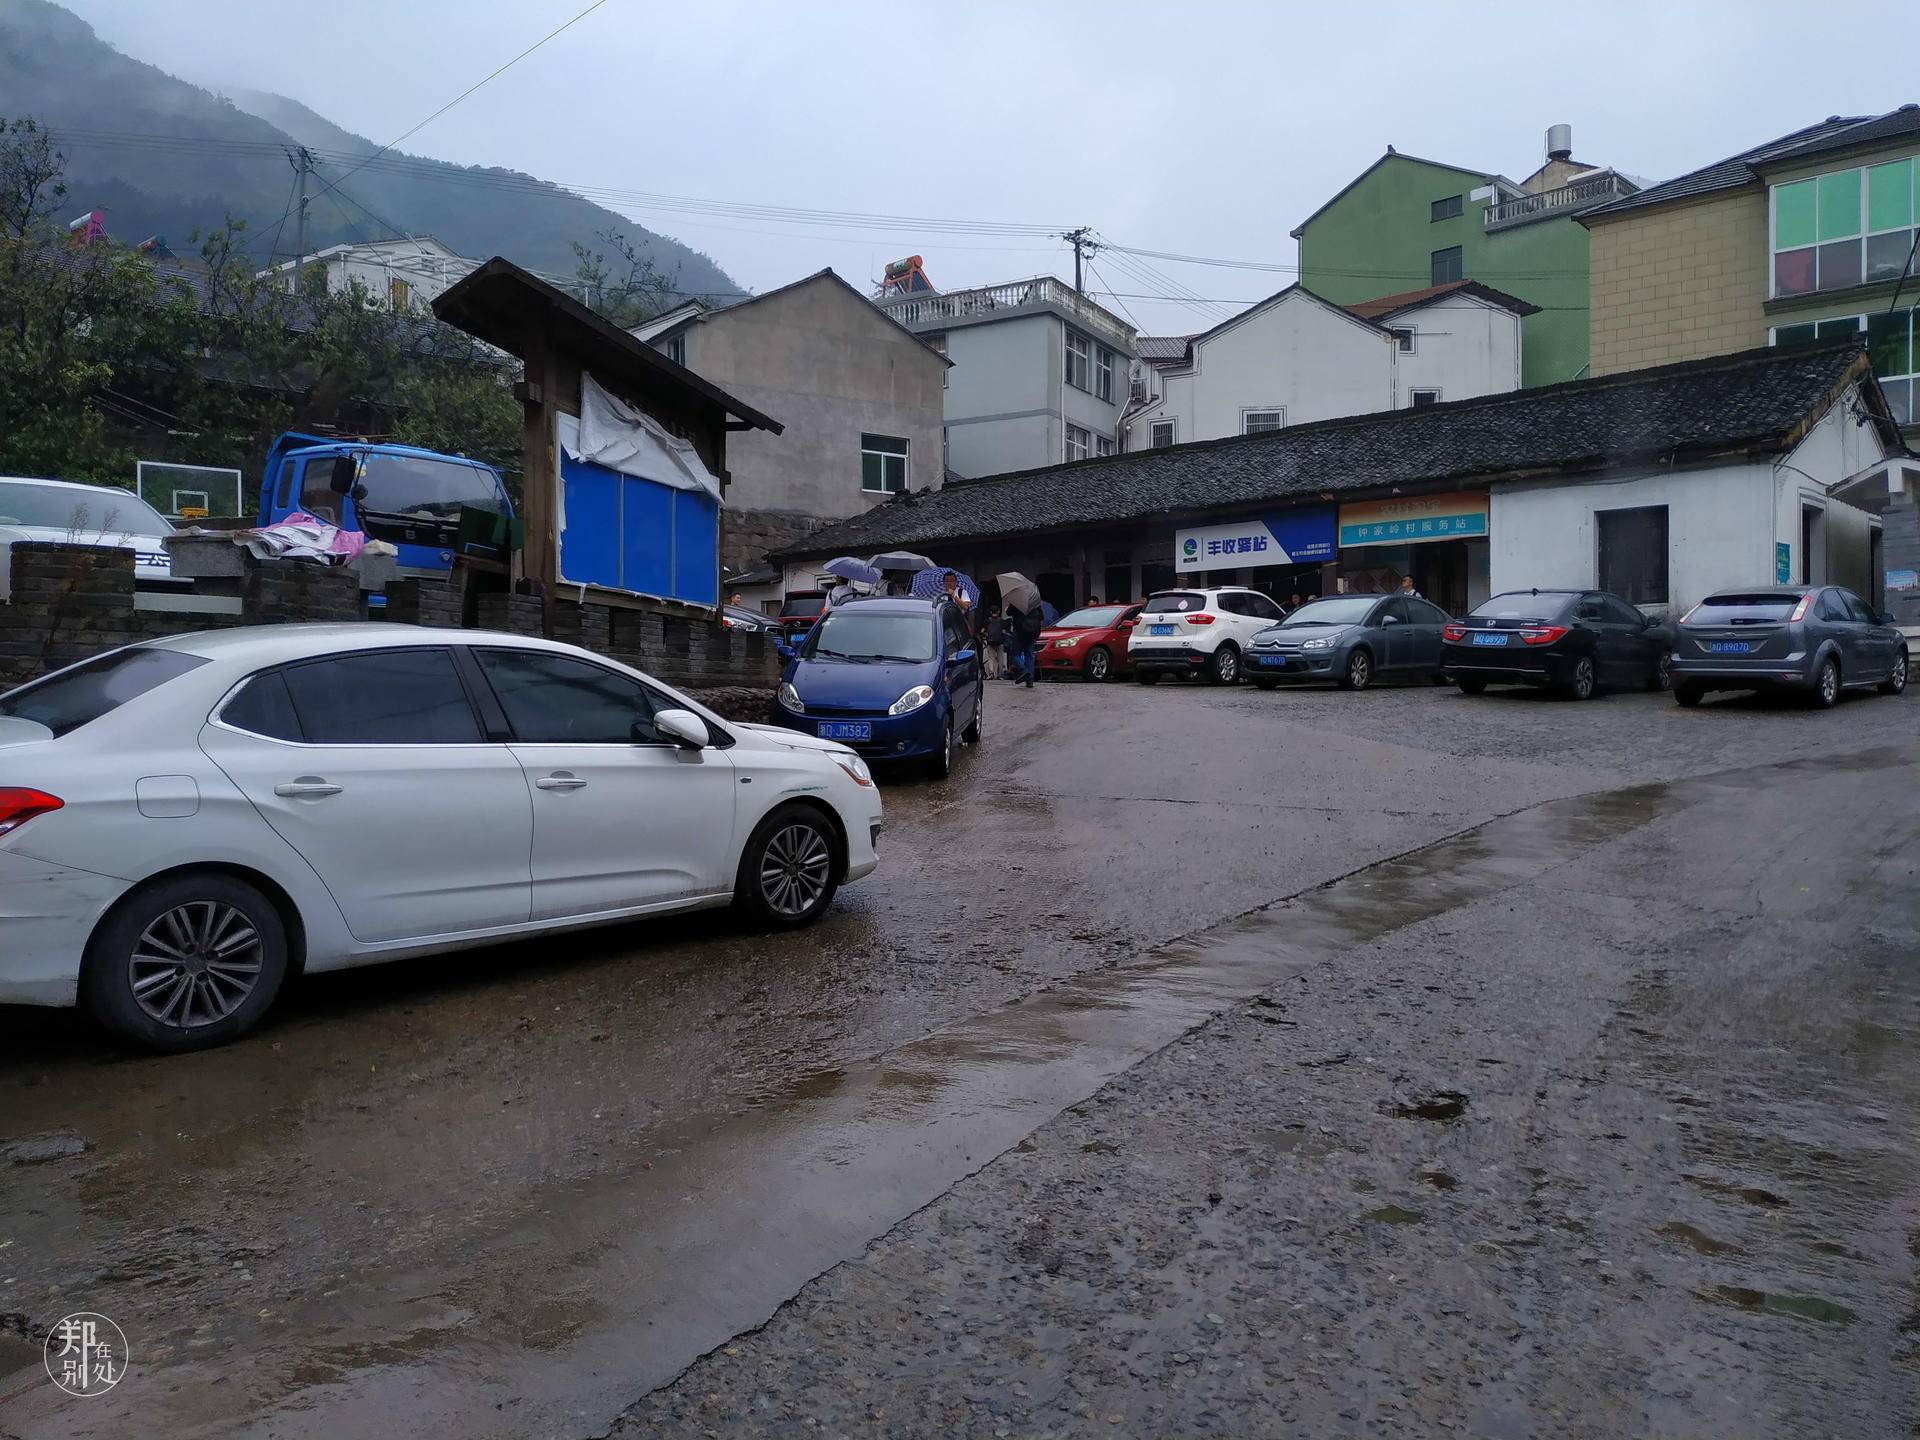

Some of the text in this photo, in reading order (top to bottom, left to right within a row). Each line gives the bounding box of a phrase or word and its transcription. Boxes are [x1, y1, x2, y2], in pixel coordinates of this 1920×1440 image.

[1358, 517, 1467, 537] 钟家岭村服务站
[1207, 535, 1268, 556] 丰收驿站
